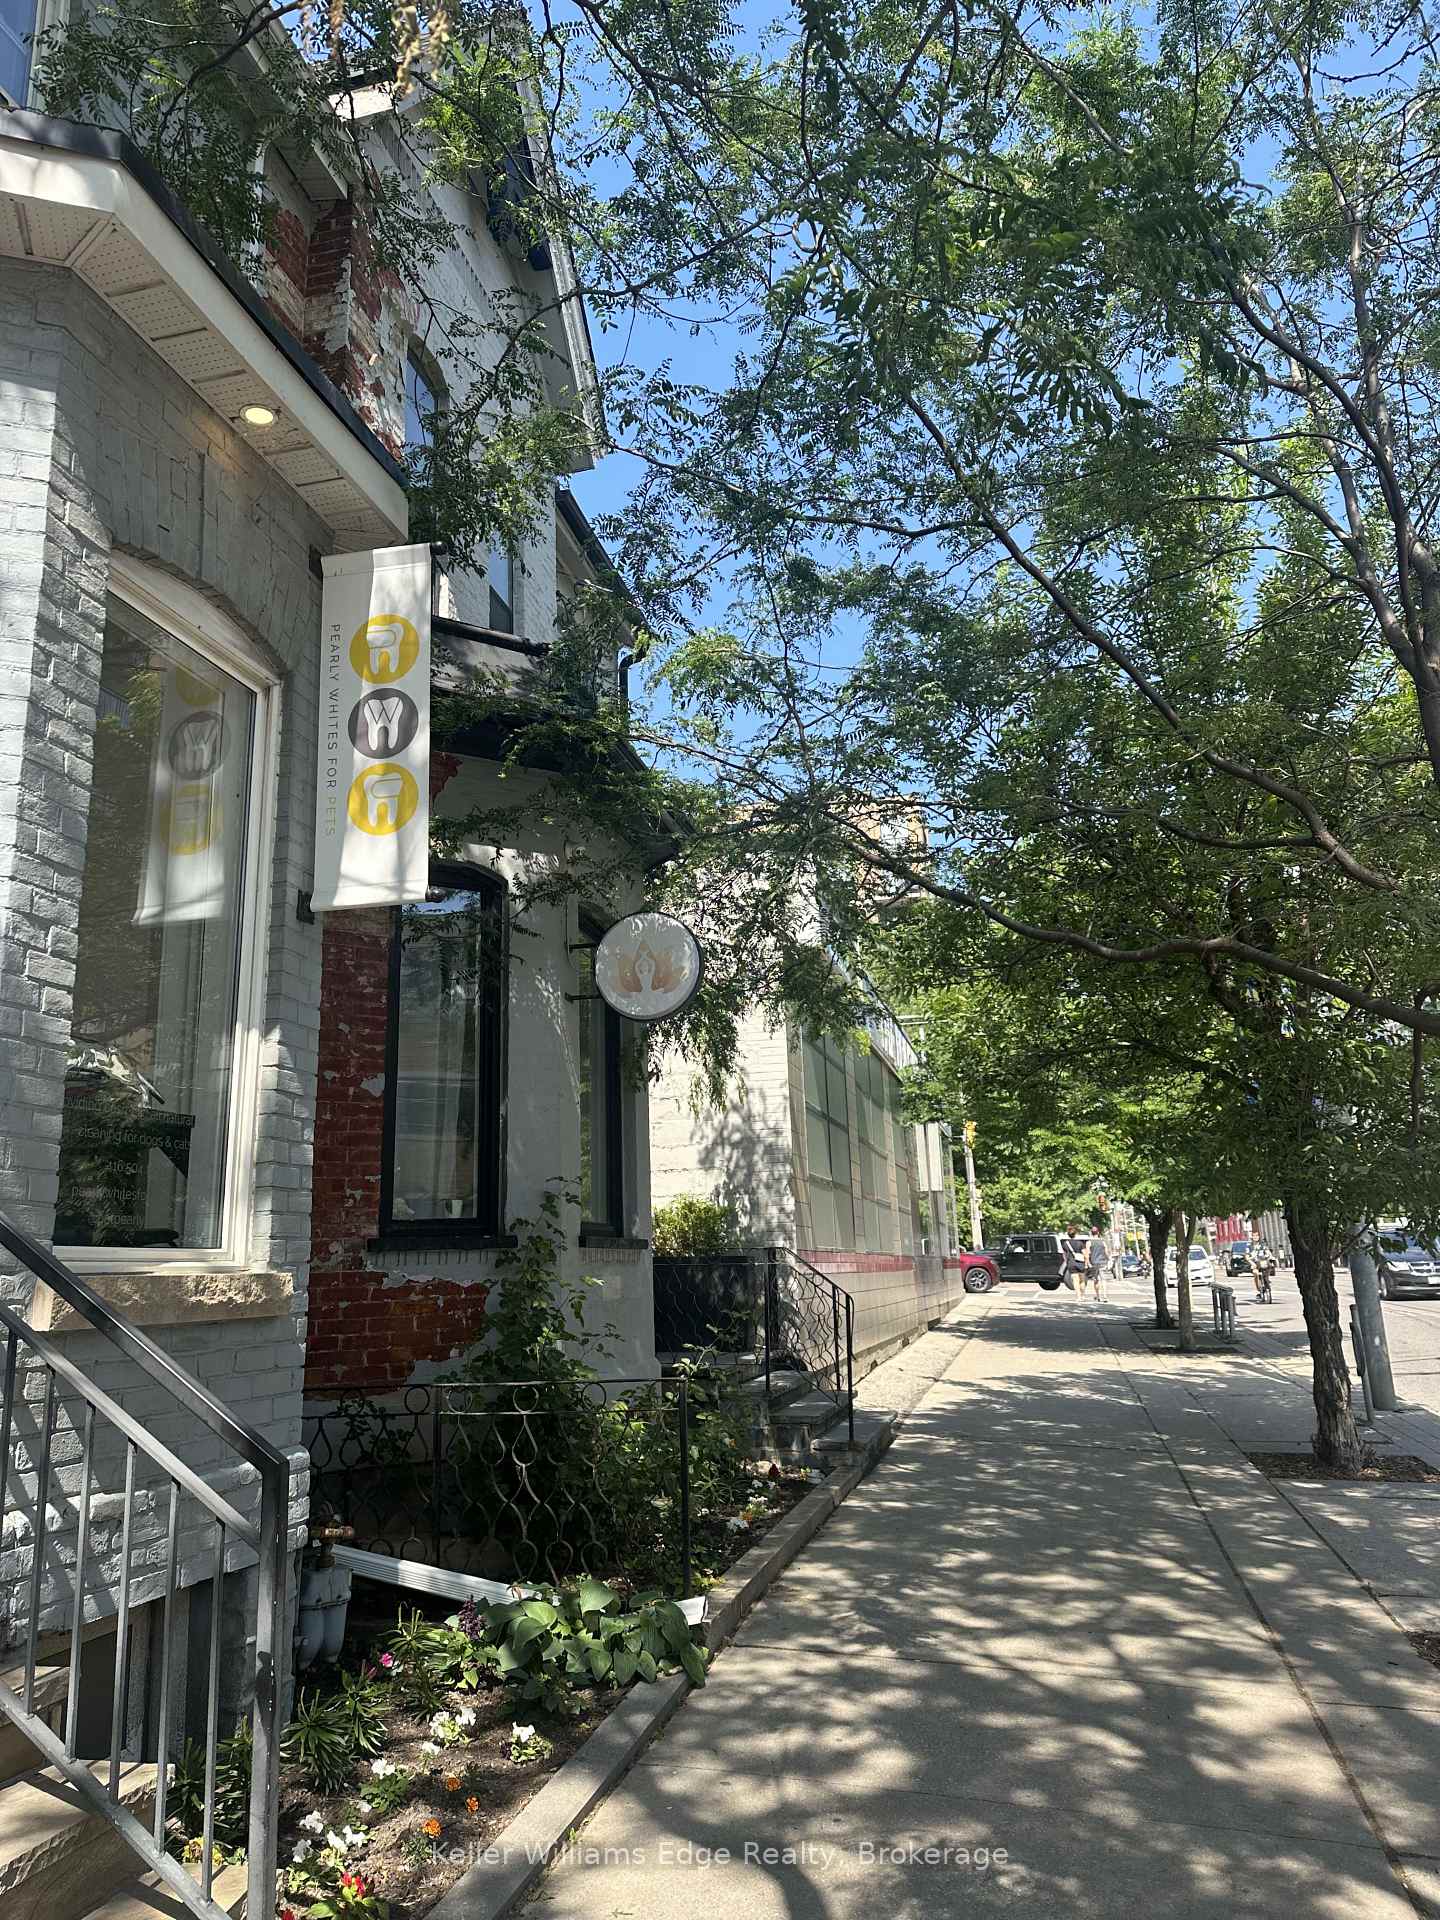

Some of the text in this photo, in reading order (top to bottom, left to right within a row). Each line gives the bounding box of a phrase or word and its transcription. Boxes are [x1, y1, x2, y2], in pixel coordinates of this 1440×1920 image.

[325, 624, 341, 836] PEARLY WHITES FOR PETS
[124, 1129, 139, 1143] for
[140, 1133, 165, 1148] dogs
[165, 1135, 172, 1148] &
